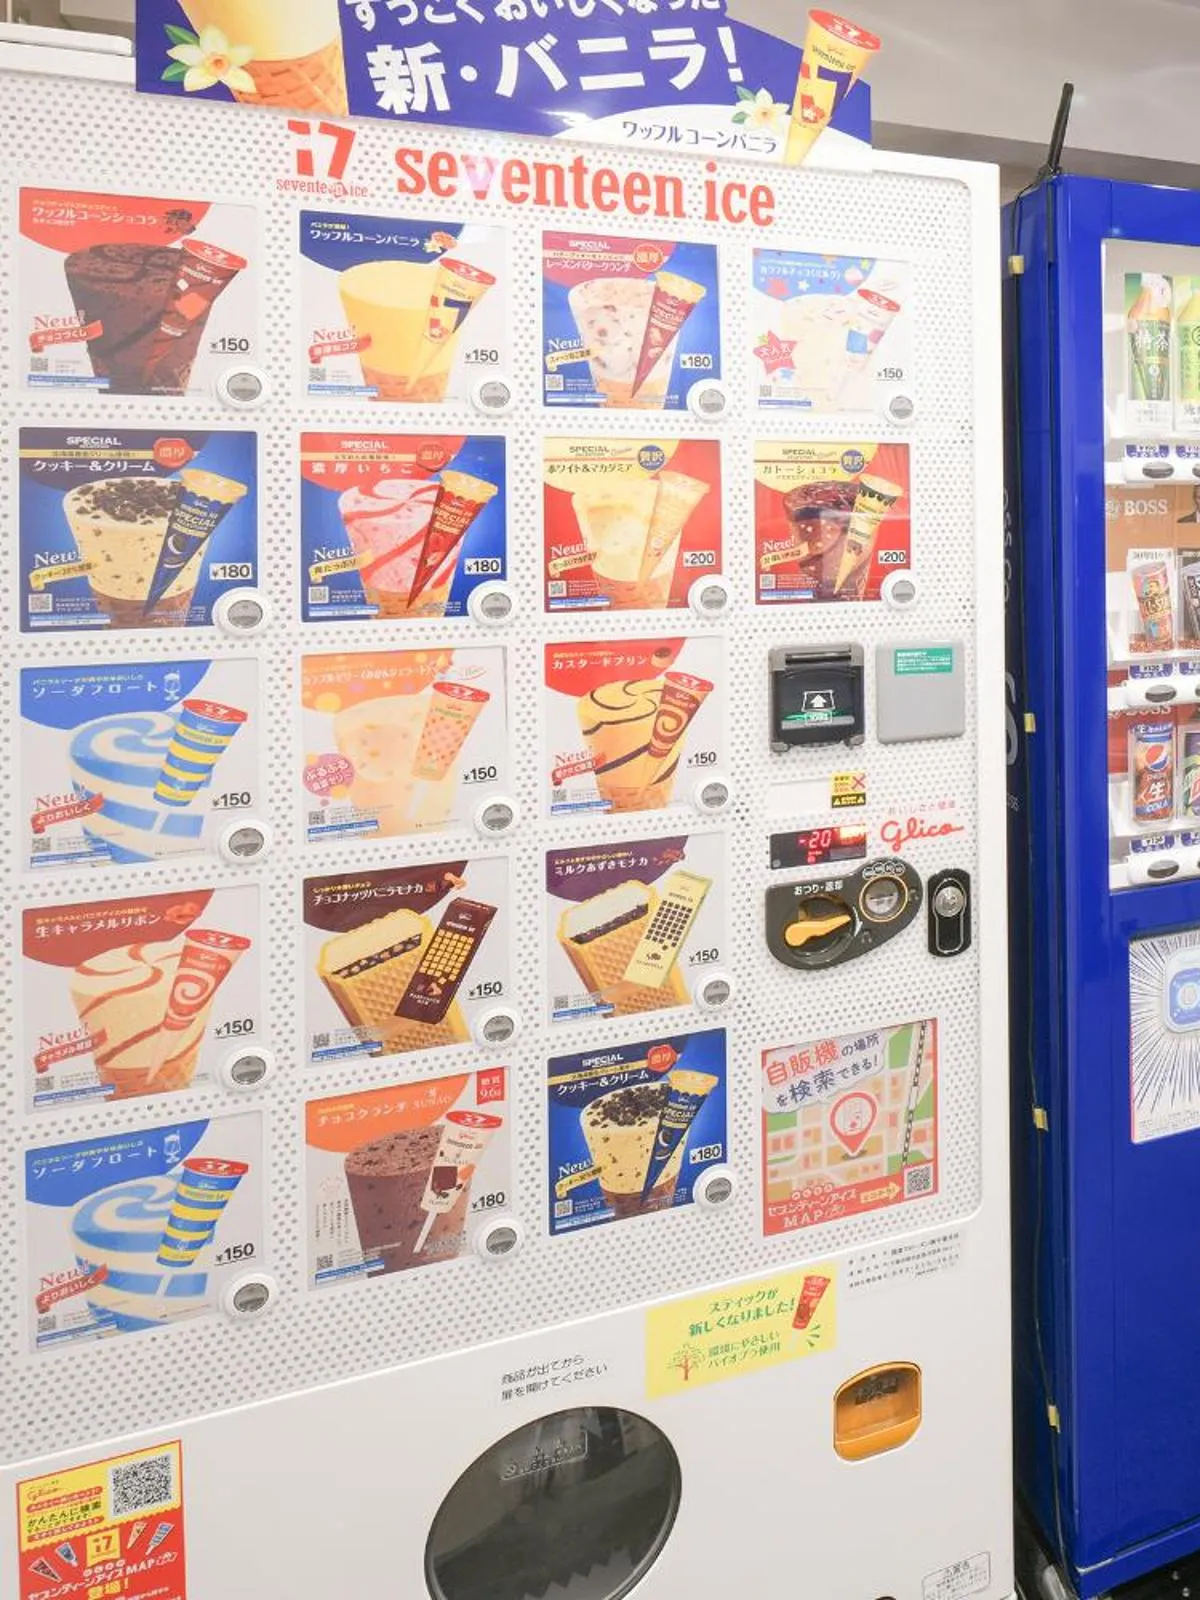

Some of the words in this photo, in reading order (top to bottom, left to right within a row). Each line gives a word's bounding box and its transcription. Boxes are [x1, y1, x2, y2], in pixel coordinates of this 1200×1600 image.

[397, 146, 683, 217] seventeen
[702, 162, 776, 226] ice
[1124, 499, 1169, 517] BOSS
[463, 765, 498, 781] ¥150
[212, 791, 252, 807] ¥150
[880, 816, 965, 853] Glico
[688, 948, 719, 964] ¥150
[468, 981, 502, 997] ¥150
[215, 1018, 254, 1036] ¥150
[766, 1032, 880, 1087] 自販機の場所
[472, 1191, 505, 1210] ¥180
[215, 1242, 255, 1263] ¥150
